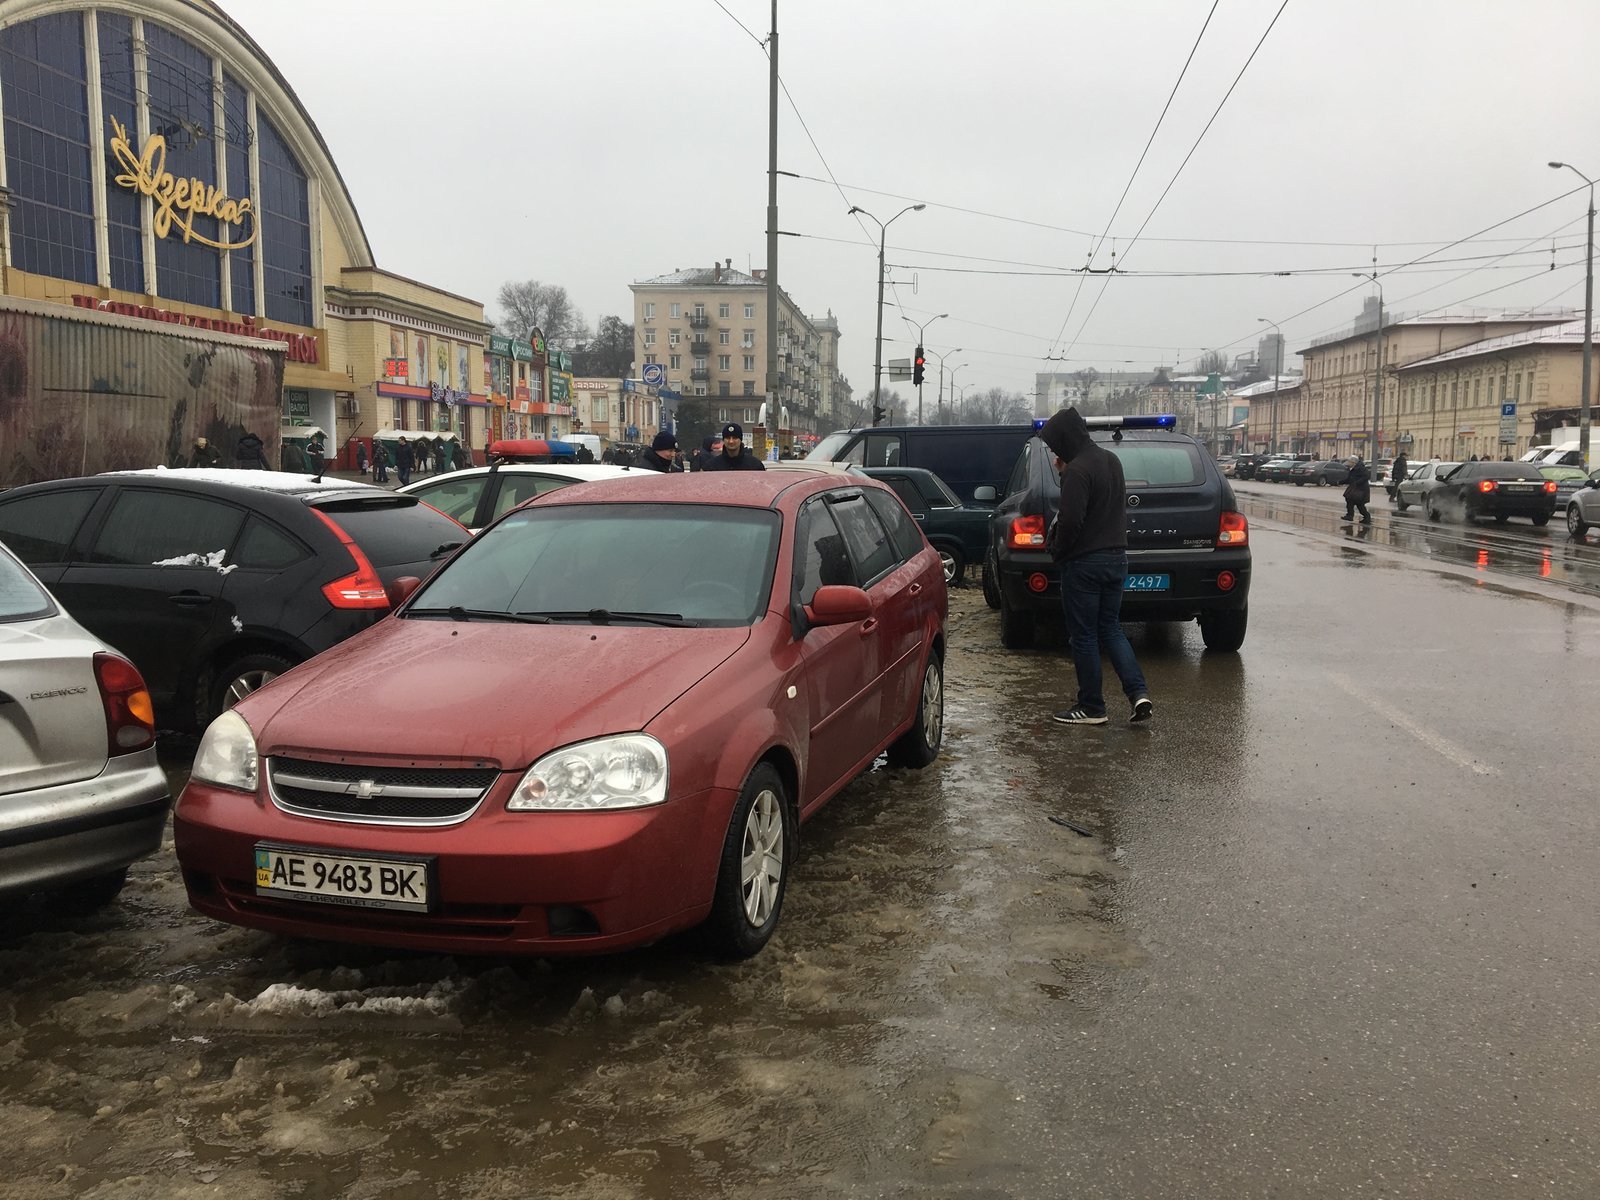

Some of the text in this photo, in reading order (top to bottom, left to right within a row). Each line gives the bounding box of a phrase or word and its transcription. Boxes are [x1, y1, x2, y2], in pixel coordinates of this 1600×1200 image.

[1129, 576, 1162, 588] 2497
[30, 686, 88, 700] DAEWOO
[258, 873, 269, 882] UA
[272, 857, 419, 898] AE 9483 BK
[310, 895, 366, 906] CHEVROLET
